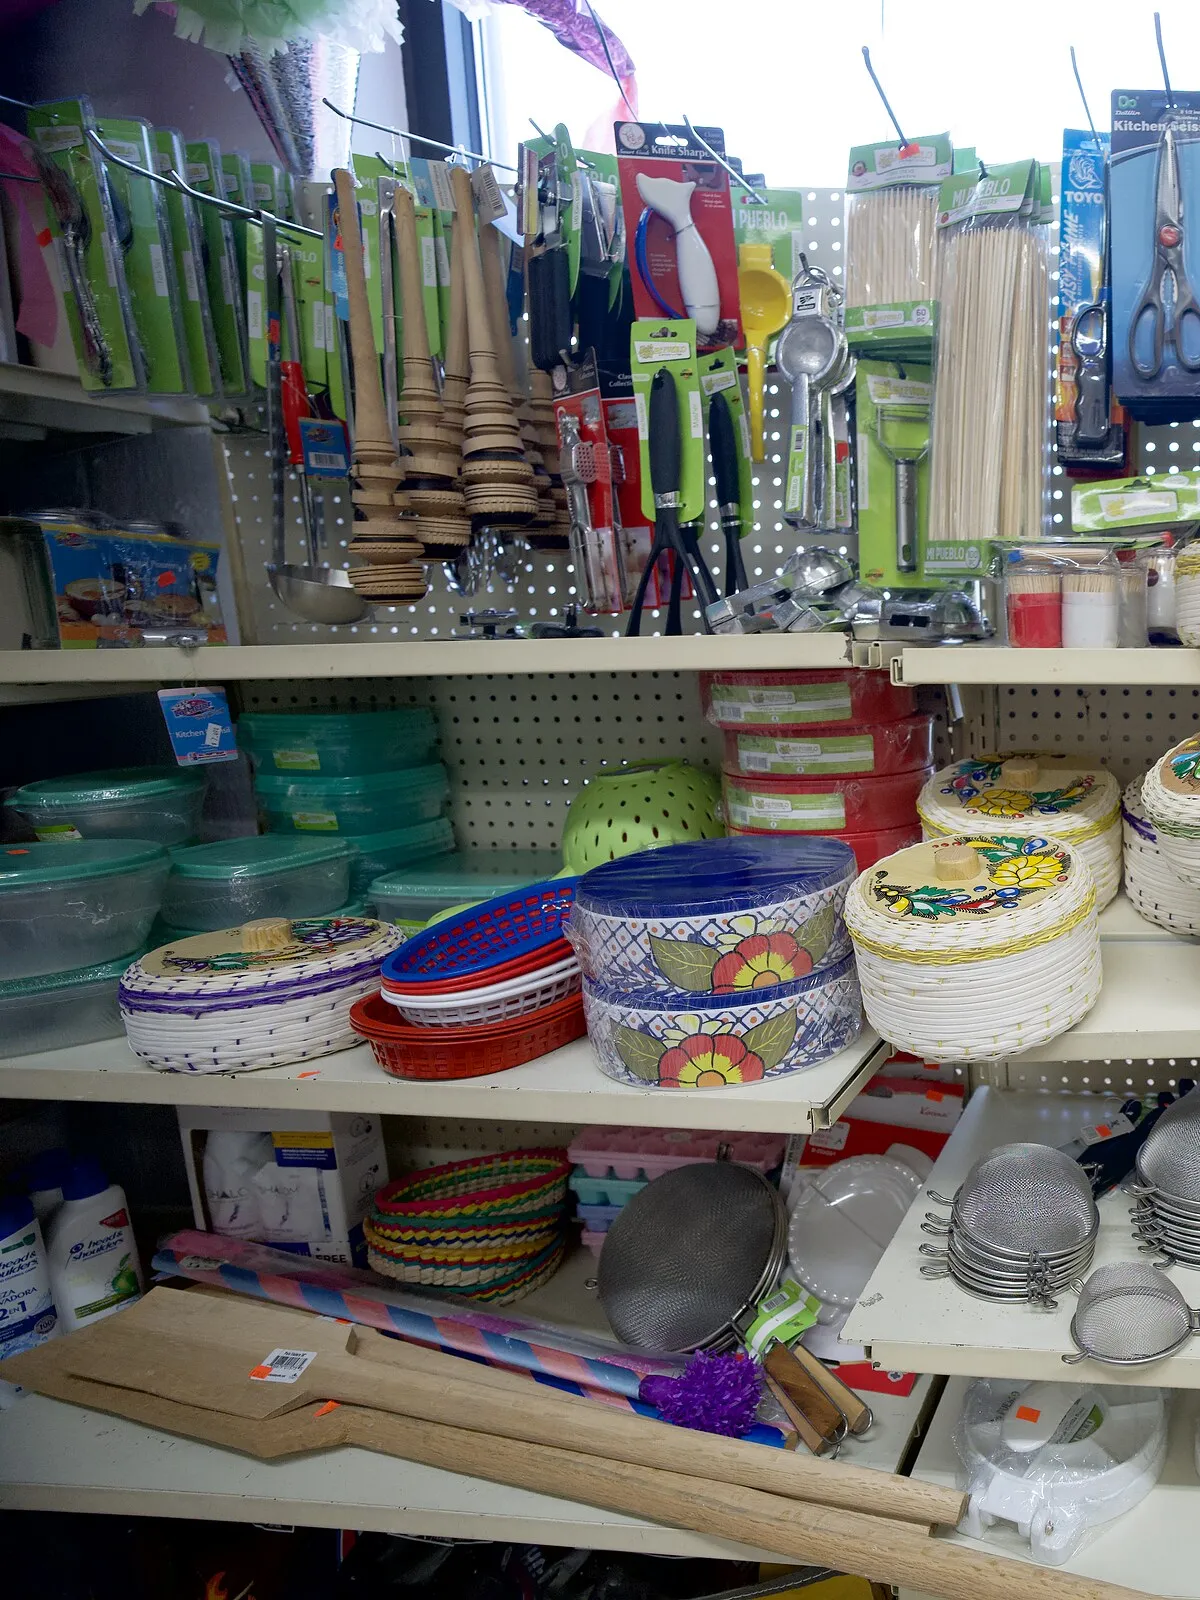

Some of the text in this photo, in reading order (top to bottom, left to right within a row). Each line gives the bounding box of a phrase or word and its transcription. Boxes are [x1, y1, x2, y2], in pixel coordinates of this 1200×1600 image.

[1113, 120, 1167, 133] Kitchen
[651, 144, 726, 158] Knife Sharpeer
[954, 191, 968, 207] MI
[968, 179, 1011, 204] PEBLO
[1064, 190, 1105, 205] TOYO
[739, 209, 788, 230] PUEBLO
[1061, 268, 1078, 308] EASY
[916, 308, 927, 317] 60
[926, 548, 965, 560] MI PUEBLO
[175, 729, 205, 739] Kitchen
[87, 1231, 116, 1249] head
[73, 1238, 124, 1260] shoulders
[315, 1253, 348, 1264] FREE
[0, 1259, 39, 1279] oulders
